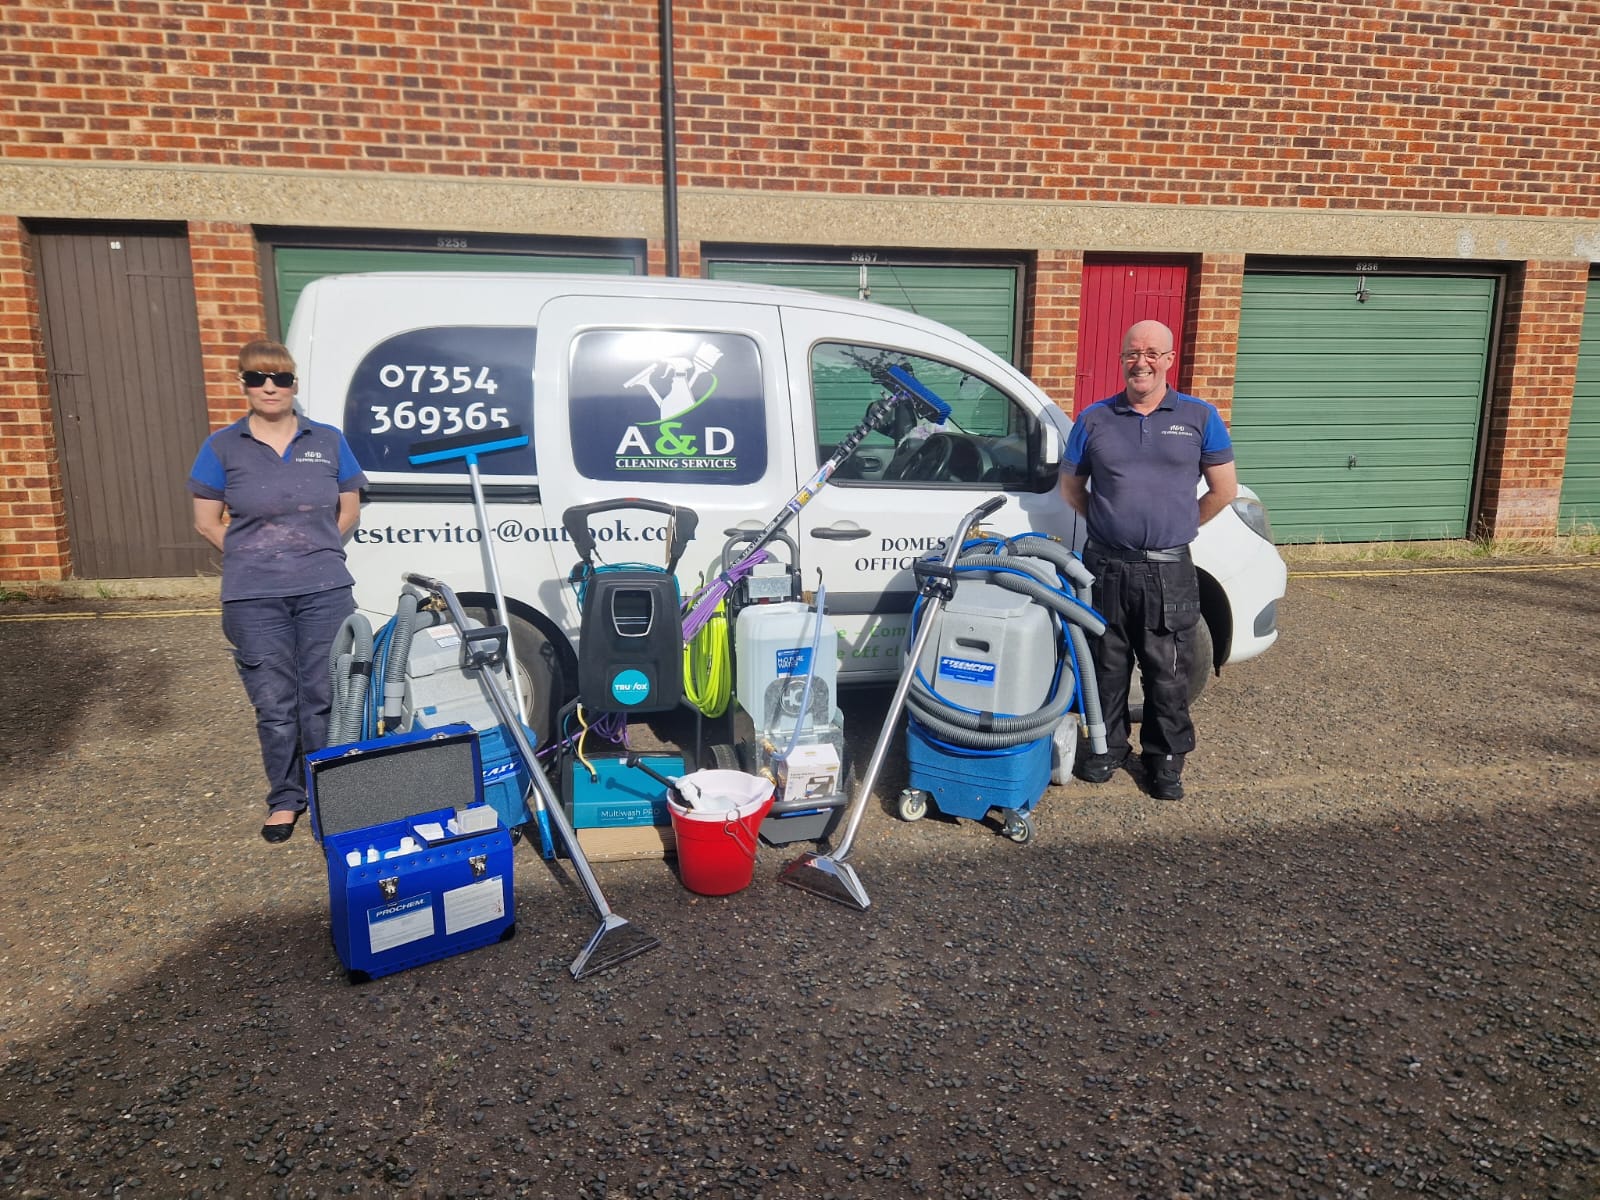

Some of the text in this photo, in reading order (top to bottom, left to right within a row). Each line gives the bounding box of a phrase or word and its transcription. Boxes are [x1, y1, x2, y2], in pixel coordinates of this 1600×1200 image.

[379, 364, 498, 395] 07354
[370, 401, 510, 435] 369365
[615, 458, 737, 469] CLEANING SERVICES
[601, 808, 641, 817] Multiwash
[375, 898, 425, 918] PROCHEM
